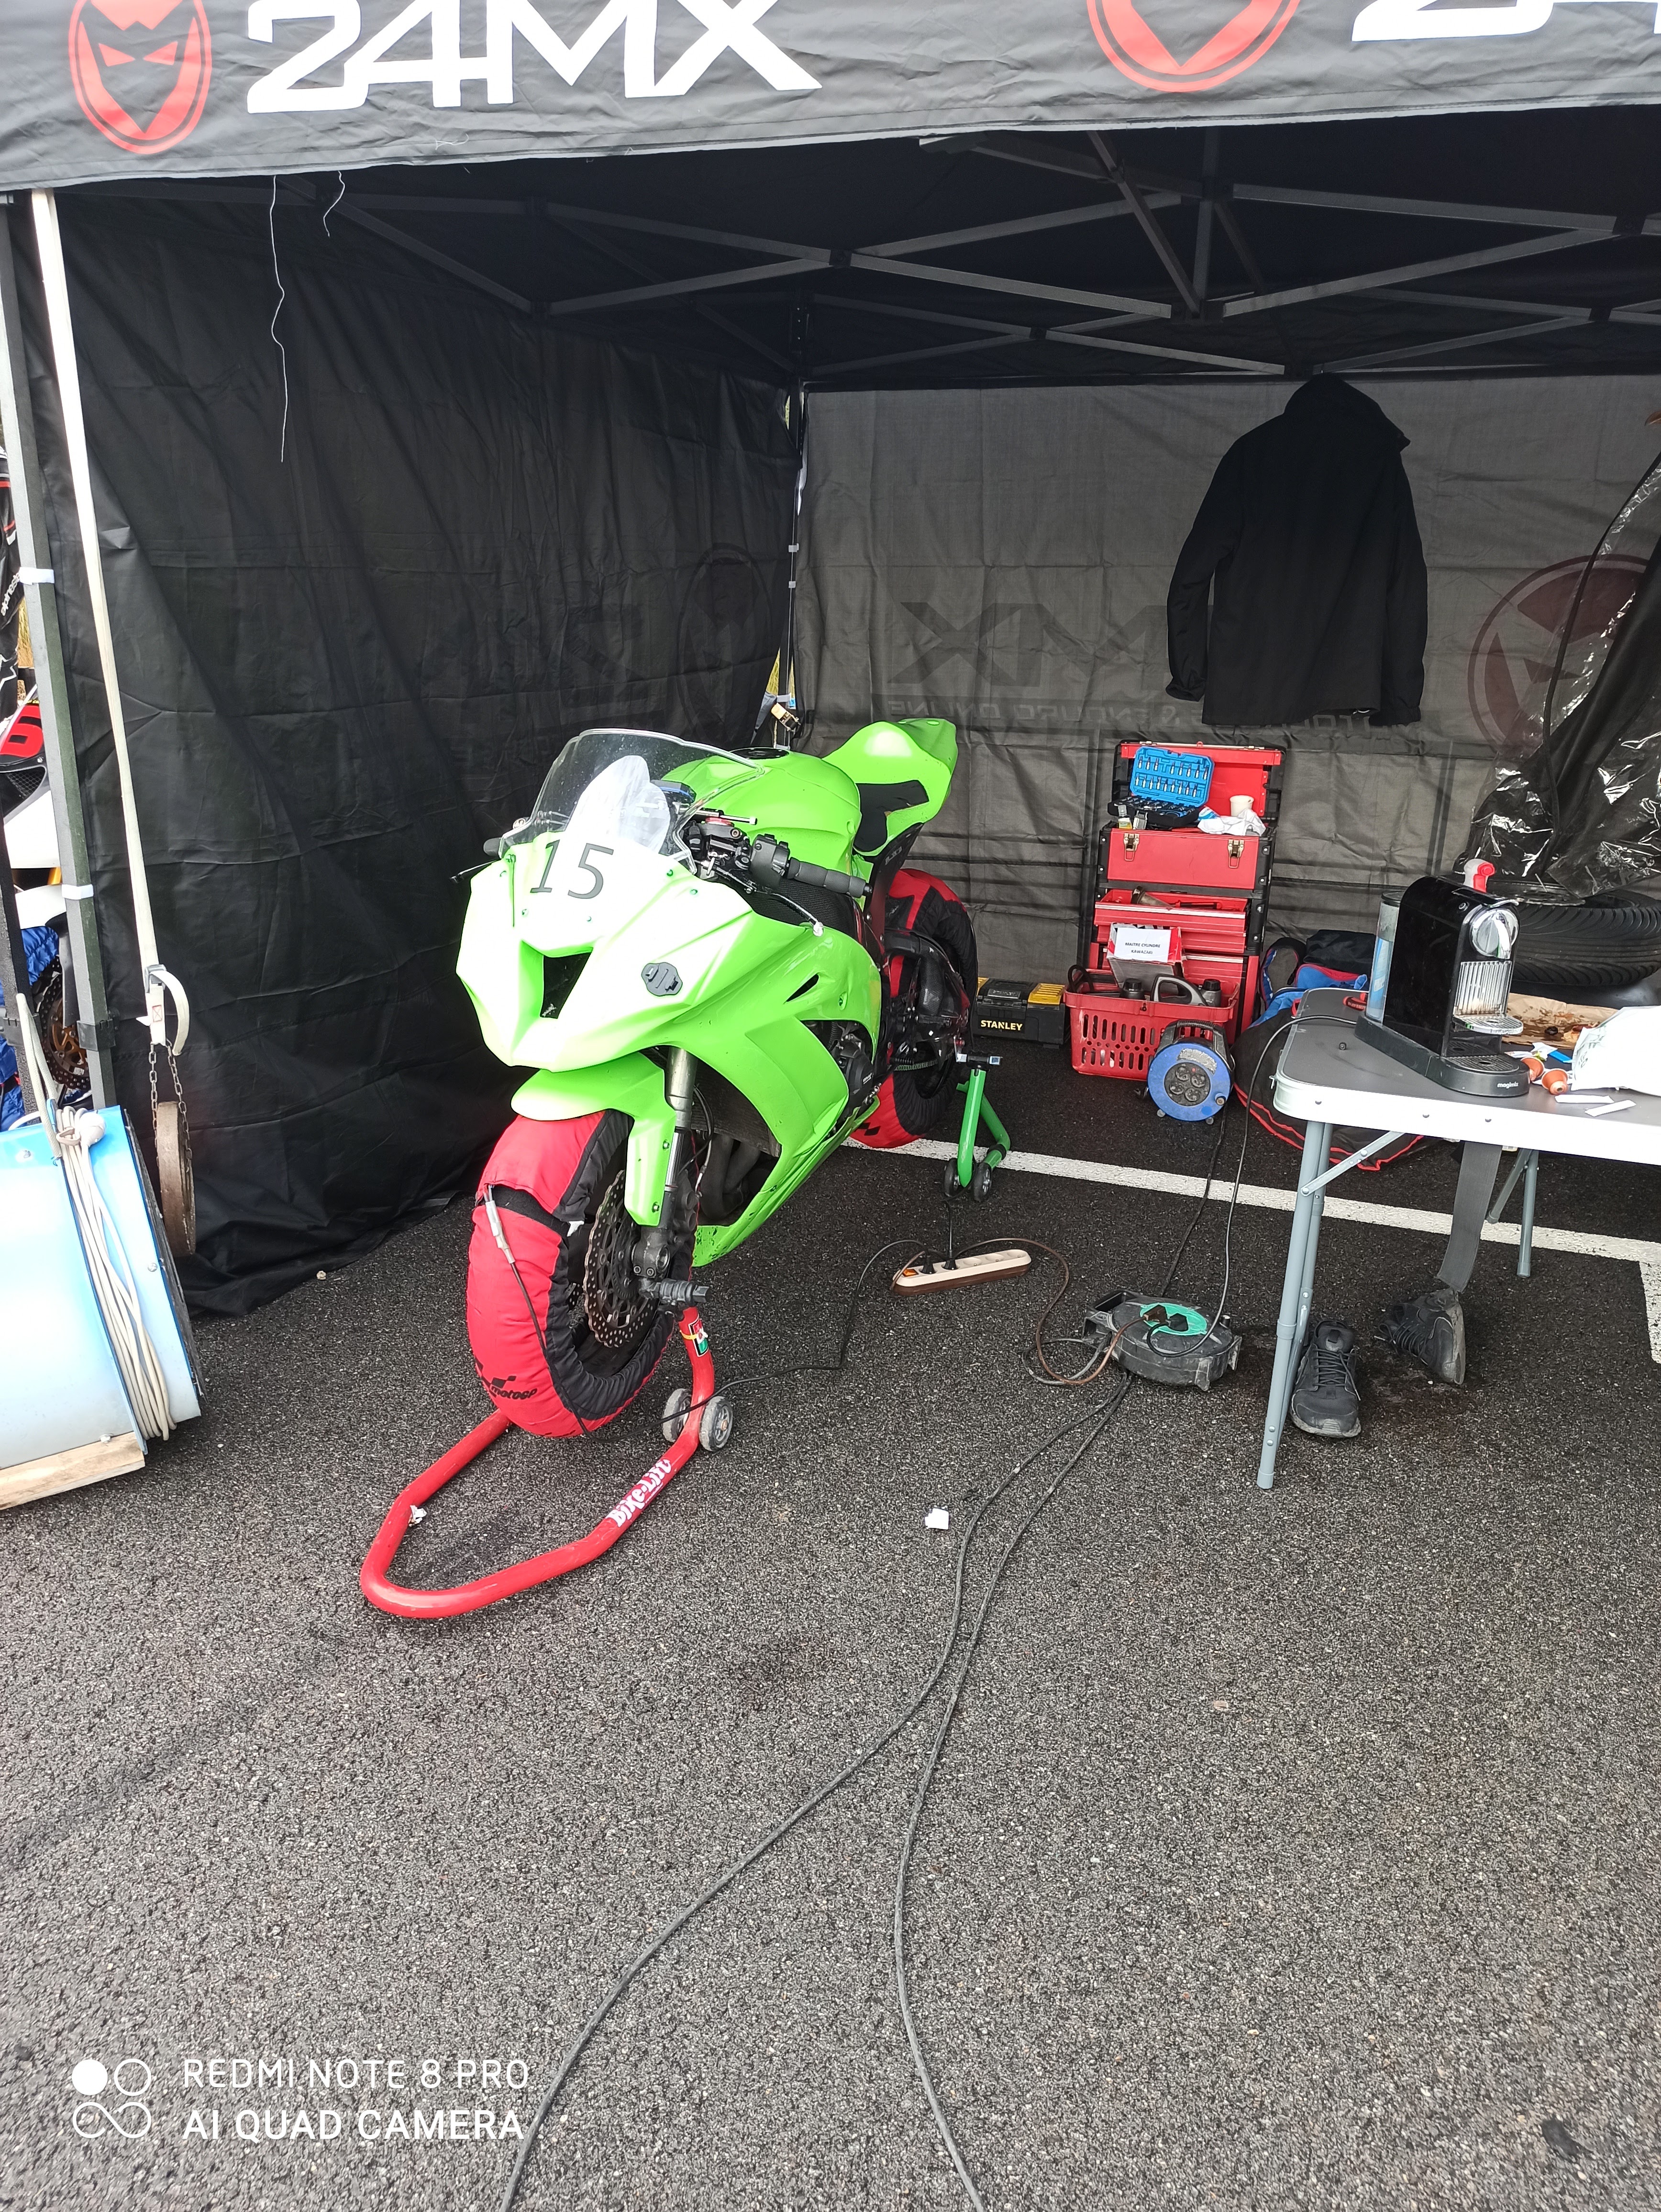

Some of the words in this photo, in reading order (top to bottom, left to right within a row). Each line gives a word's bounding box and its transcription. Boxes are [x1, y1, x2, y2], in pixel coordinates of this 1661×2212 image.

[247, 0, 823, 114] 24MX
[530, 839, 614, 899] 15
[981, 1020, 1022, 1031] STANLEY
